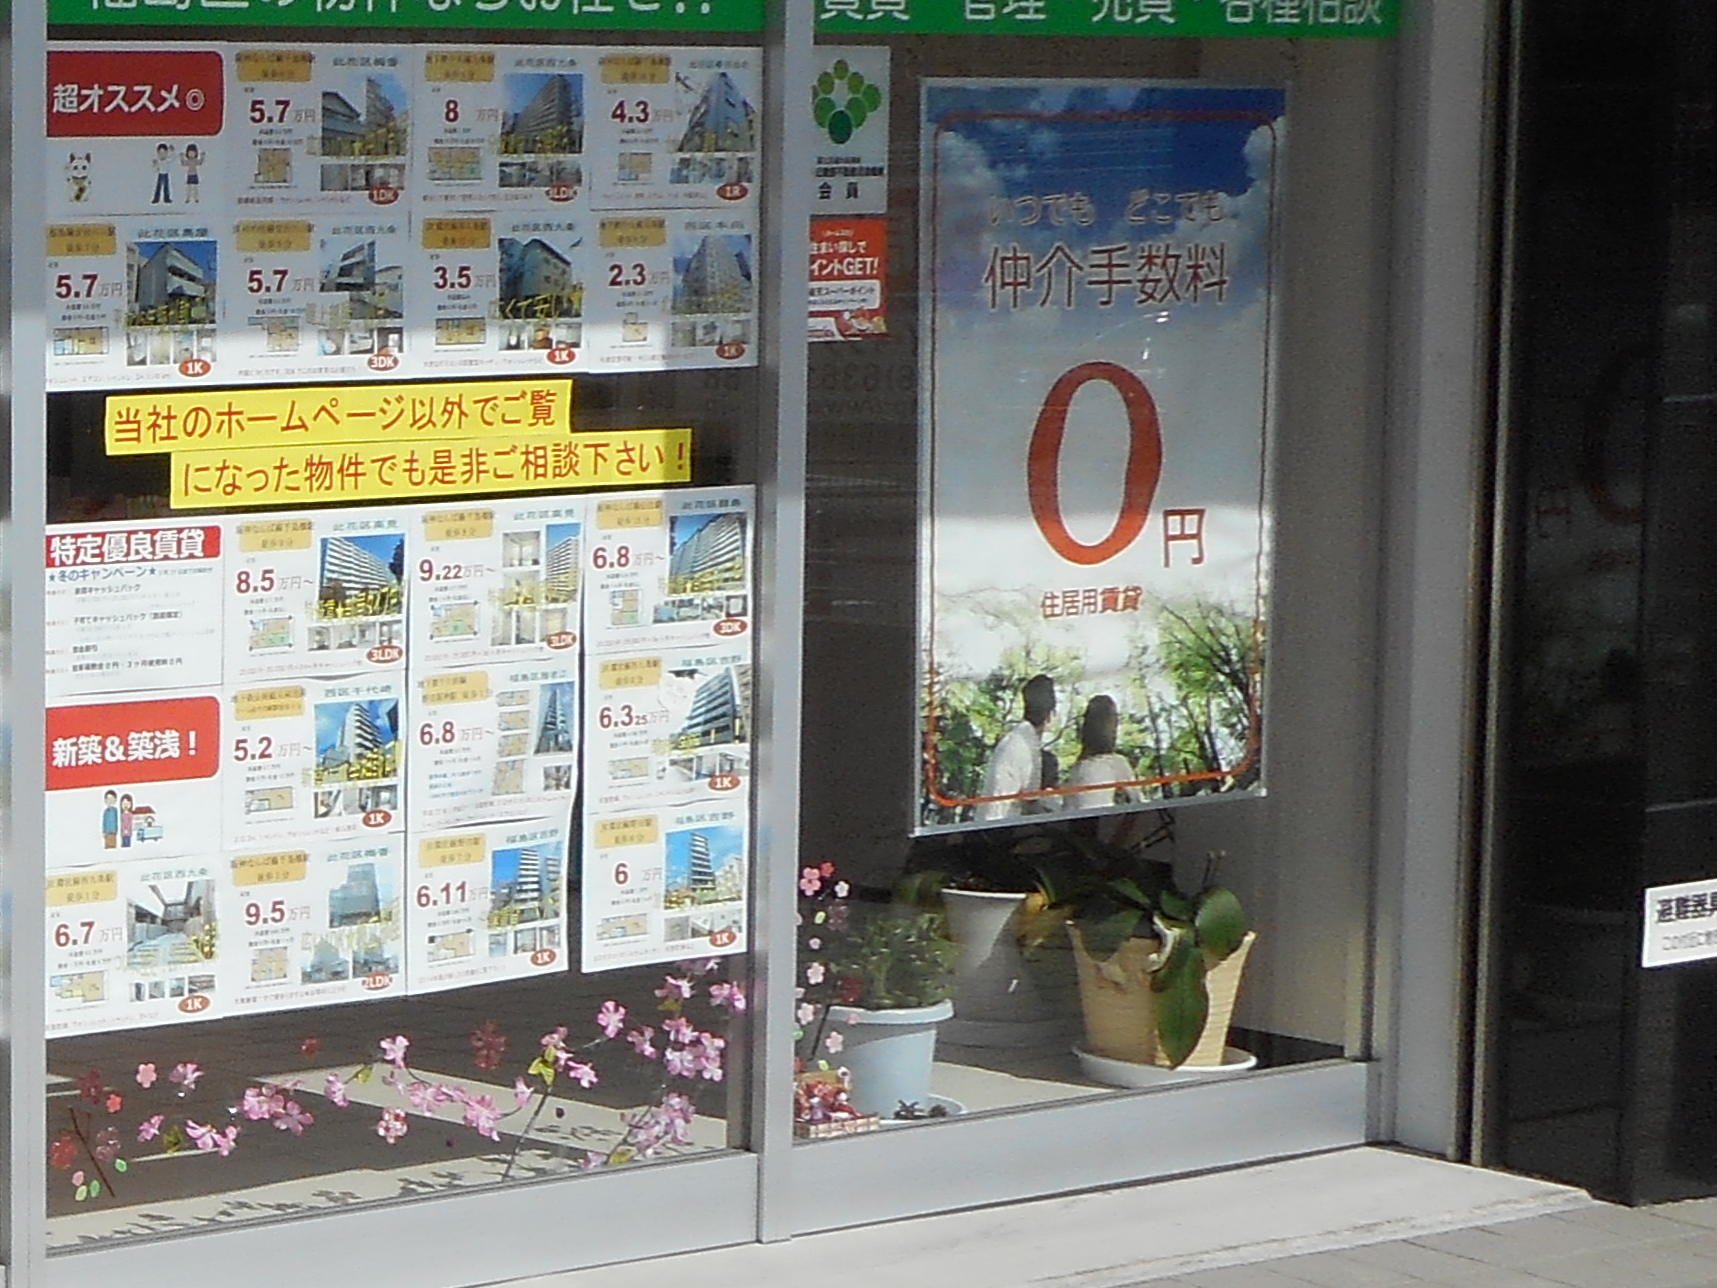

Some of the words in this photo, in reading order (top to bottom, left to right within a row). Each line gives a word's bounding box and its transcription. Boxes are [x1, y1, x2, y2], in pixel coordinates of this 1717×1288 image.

[982, 240, 1230, 313] 仲介手数料
[186, 361, 204, 374] 1K
[370, 355, 397, 370] 3DK
[114, 389, 558, 445] 当社のホームページ以外でご覧
[50, 528, 205, 566] 特定優良賃貸
[1040, 584, 1143, 619] 住居用賃貸
[714, 776, 733, 789] 1K
[368, 812, 385, 824] 1K
[186, 998, 203, 1011] 1K
